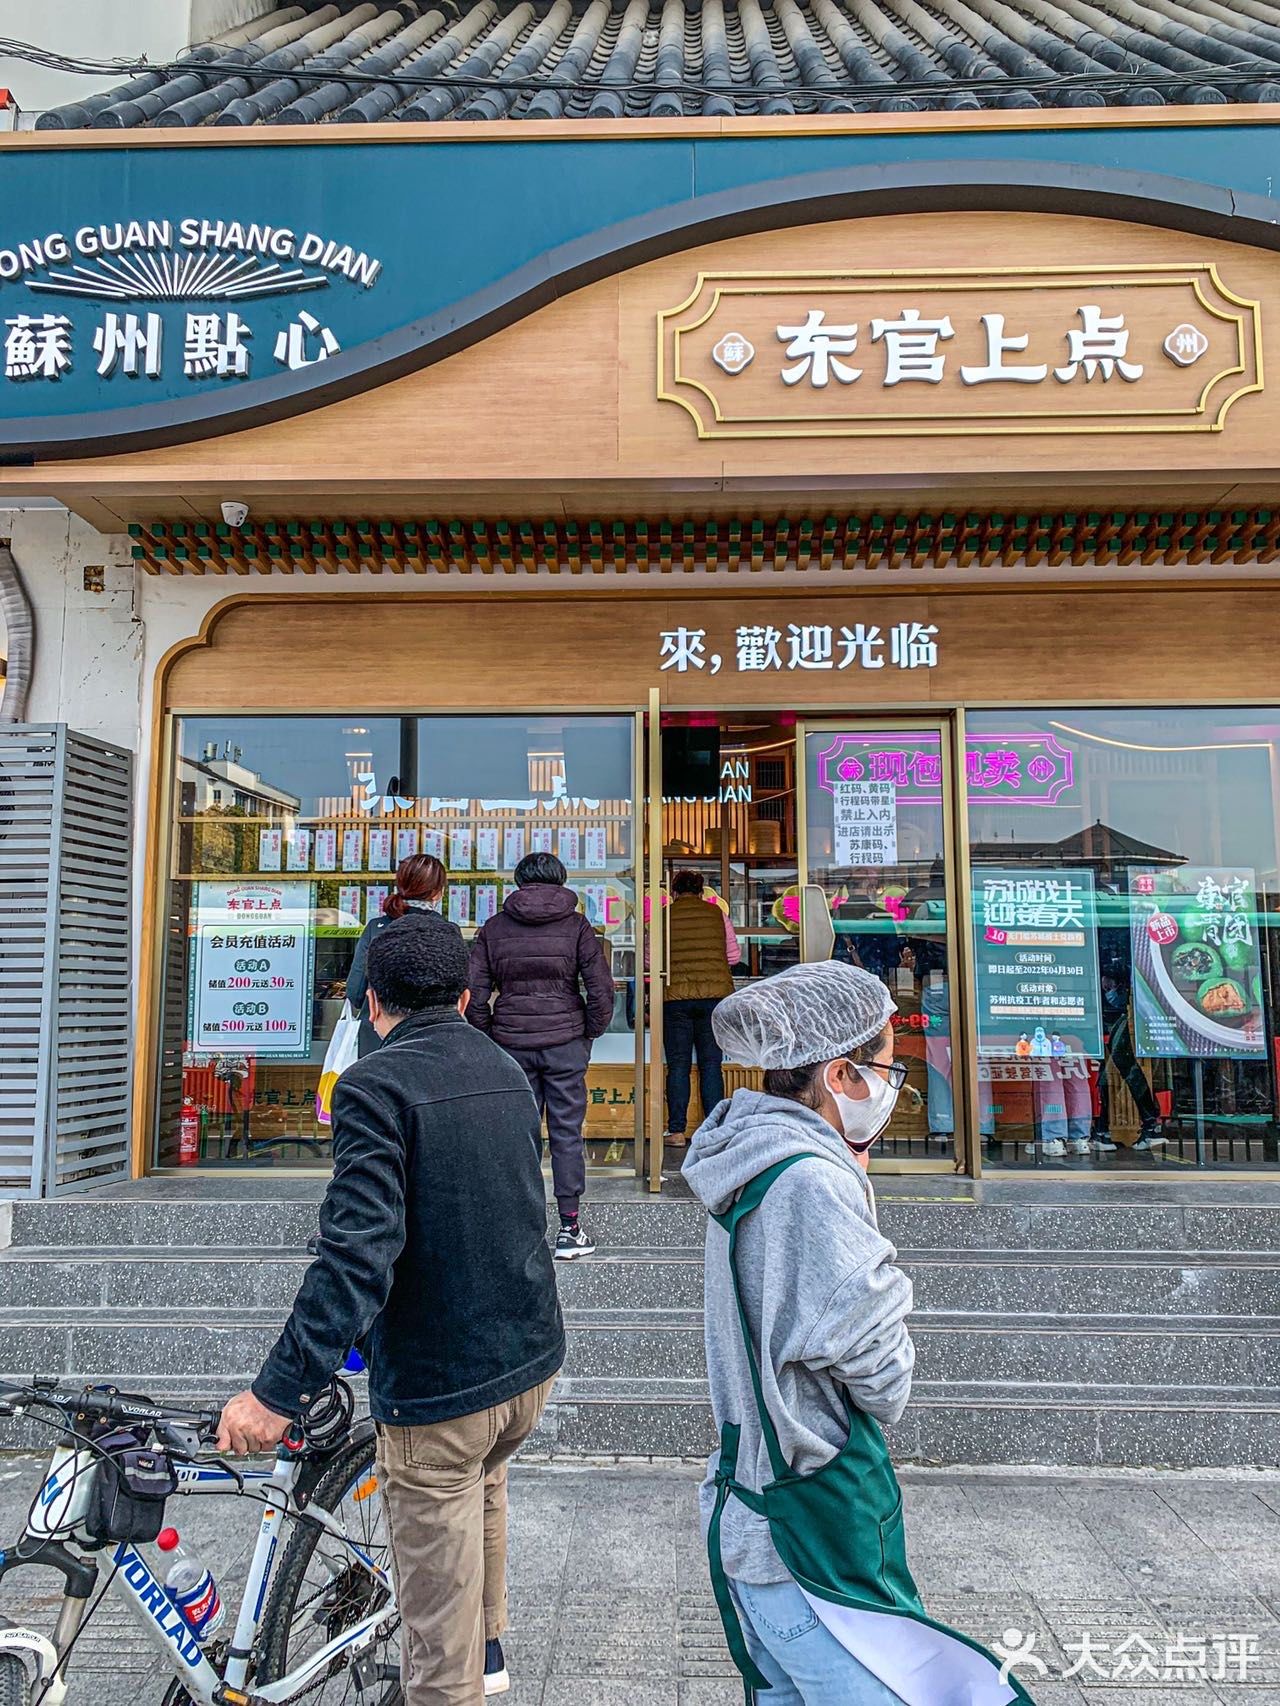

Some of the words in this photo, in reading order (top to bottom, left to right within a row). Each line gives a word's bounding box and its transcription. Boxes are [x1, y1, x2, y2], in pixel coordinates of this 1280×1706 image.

[75, 220, 171, 254] GUAN
[180, 219, 296, 257] SHANG
[299, 233, 381, 288] DIAN
[4, 310, 342, 379] 蘇州點心
[775, 304, 1144, 388] 东官上点
[840, 783, 891, 794] 红码、黄码
[840, 796, 891, 807] 行程码带星
[840, 808, 891, 821] 禁止入内
[837, 825, 895, 837] 进店请出示
[849, 852, 884, 864] 行程码
[227, 898, 283, 910] 东官上点
[1157, 926, 1176, 941] 上市
[210, 935, 296, 949] 会员充值活动
[1019, 953, 1053, 963] 活动时间
[236, 960, 268, 972] 活动A
[208, 977, 295, 989] 储值200元送30元
[1020, 984, 1054, 993] 活动对象
[990, 995, 1085, 1006] 苏州抗疫工作者和志愿者
[234, 1003, 266, 1015] 活动B
[203, 1020, 297, 1032] 储值500元送100元
[113, 1541, 203, 1667] VORLAD
